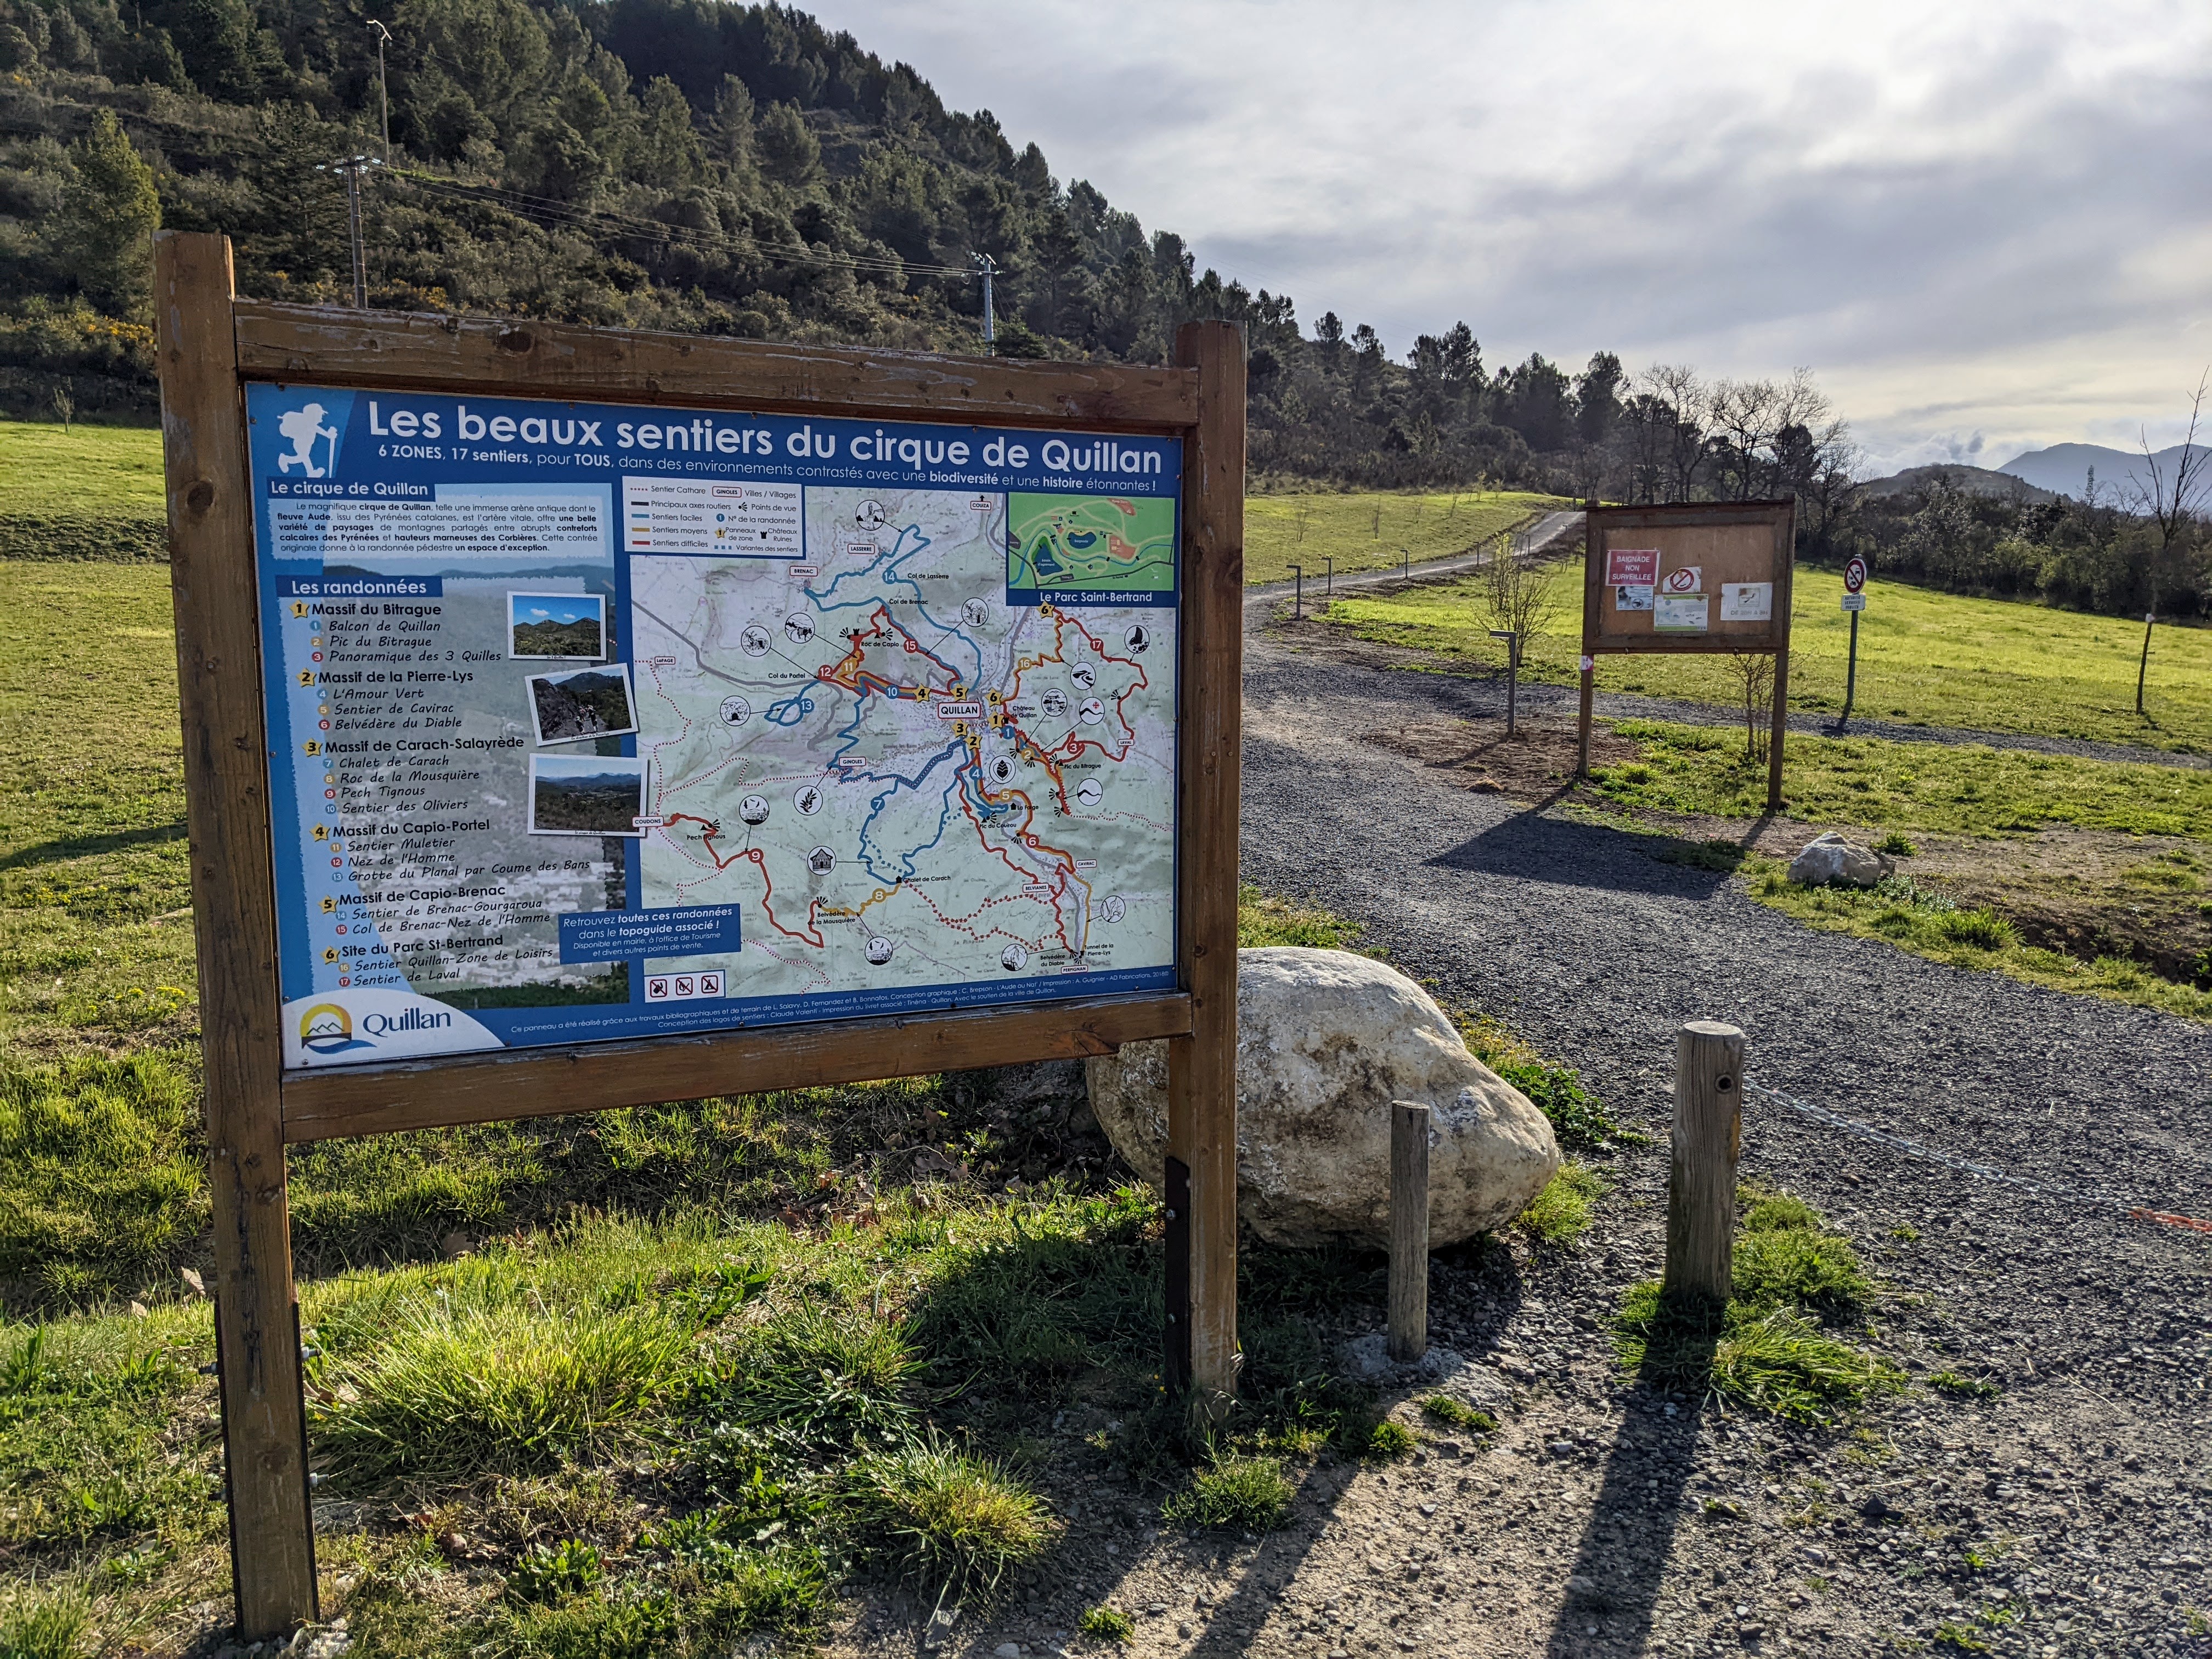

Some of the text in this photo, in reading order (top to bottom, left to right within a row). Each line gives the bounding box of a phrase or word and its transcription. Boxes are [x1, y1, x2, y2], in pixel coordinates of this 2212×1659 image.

[369, 400, 1161, 474] Les beaux sentiers du cirque de Quillan
[378, 444, 1156, 492] 6 ZONES, 17 sentiers, pour TOUS, dans des environnements contrastés avec une biodiversité et une histoire étonnantes !
[271, 481, 428, 496] Le cirque de Quillan
[651, 485, 706, 494] Sentier Cathare
[744, 489, 763, 498] Villes
[769, 490, 797, 500] Villages
[308, 503, 357, 512] magnifique
[359, 503, 386, 512] cirque
[402, 503, 433, 511] Quillan,
[472, 504, 509, 512] immense
[510, 504, 534, 512] arène
[536, 505, 567, 514] antique
[652, 513, 679, 521] Sentiers
[278, 522, 308, 531] variété
[314, 523, 326, 531] de
[332, 524, 374, 533] paysages
[398, 524, 445, 533] montagnes
[451, 523, 488, 533] partagés
[521, 524, 551, 533] abrupts
[556, 524, 597, 532] contreforts
[652, 526, 679, 534] Sentiers
[652, 539, 680, 547] Sentiers
[292, 580, 427, 595] Les randonnées
[1040, 591, 1153, 603] Le Parc Saint-Bertrand
[312, 603, 442, 618] Massif du Bitrague
[329, 620, 441, 633] Balcon de Quillan
[329, 635, 432, 649] Pic du Bitrague
[329, 650, 501, 663] Panoramique des 3 Quilles
[318, 670, 473, 684] Massif de la Pierre-Lys
[333, 687, 424, 700] L'Amour Vert
[334, 702, 454, 715] Sentier de Cavirac
[940, 706, 978, 715] QUILLAN
[335, 716, 462, 730] Belvédère du Diable
[325, 736, 524, 753] Massif de Carach-Salayrède
[339, 754, 449, 769] Chalet de Carach
[340, 769, 480, 784] Roc de la Mousquière
[341, 785, 426, 799] Pech Tignous
[341, 799, 469, 814] Sentier des Oliviers
[332, 819, 490, 837] Massif du Capio-Portel
[347, 837, 455, 852] Sentier Muletier
[347, 853, 455, 867] Nez de l'Homme
[339, 885, 506, 905] Massif de Capio-Brenac
[563, 906, 732, 928] Retrouvez toutes ces randonnées
[578, 919, 719, 939] dans le topoguide associé !
[342, 934, 503, 957] Site du Parc St-Bertrand
[354, 948, 553, 972] Sentier Quillan-Zone de Loisirs
[362, 1007, 451, 1038] Quillan
